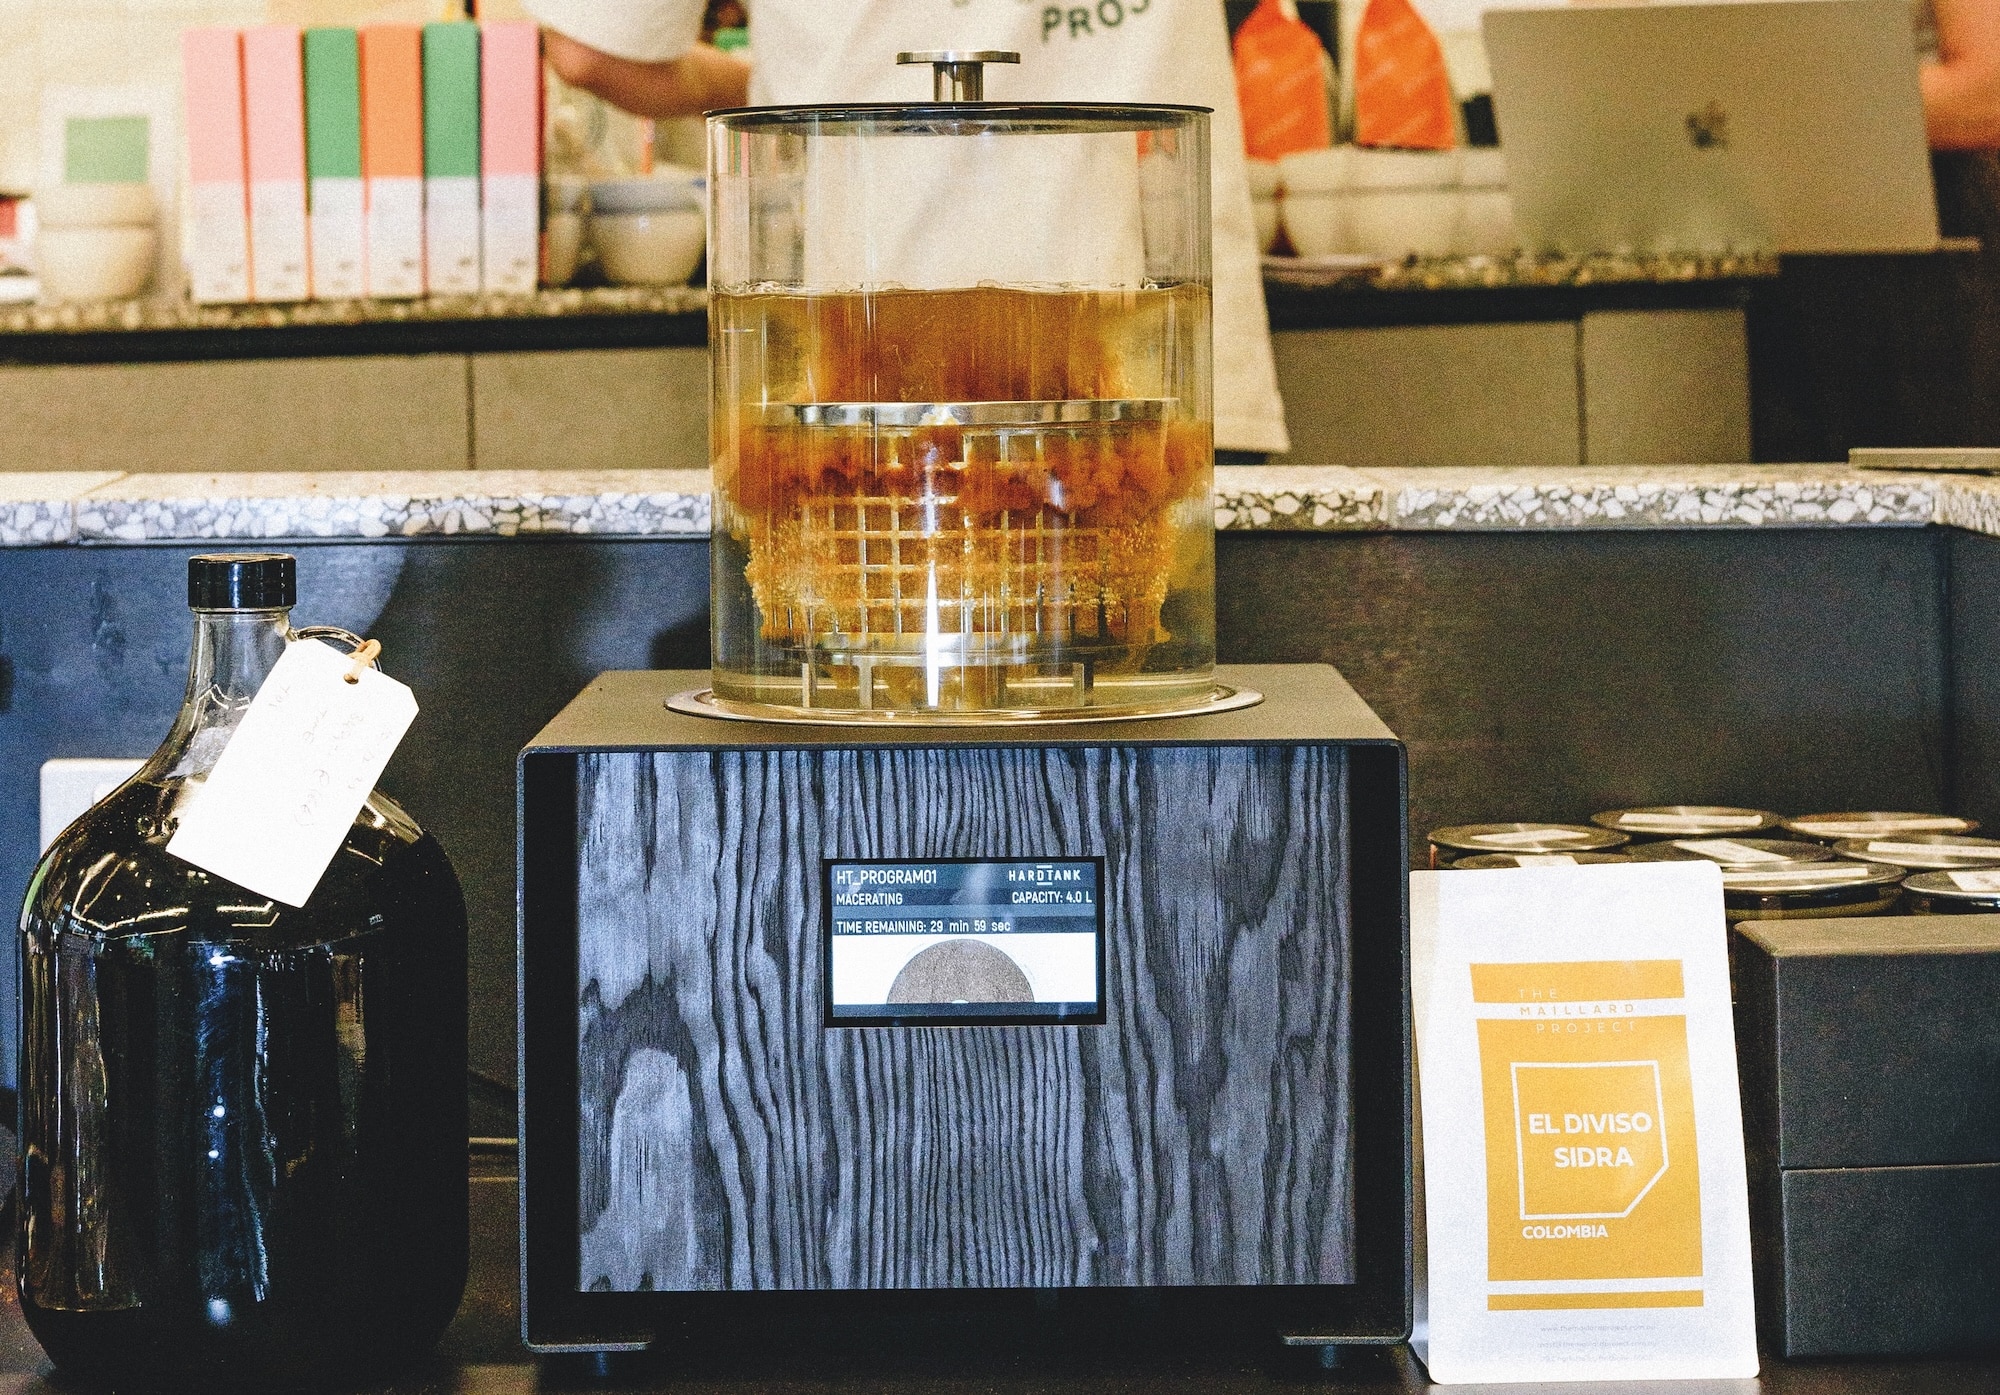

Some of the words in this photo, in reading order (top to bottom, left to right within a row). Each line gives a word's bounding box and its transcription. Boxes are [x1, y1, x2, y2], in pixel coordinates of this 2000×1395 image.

[836, 869, 937, 885] HT_PROGRAM01
[1008, 868, 1081, 882] HARDTANK
[836, 893, 903, 905] MACERATING
[1011, 891, 1064, 904] CAPACITY:
[1066, 890, 1082, 904] 4.0
[1085, 890, 1092, 904] L
[836, 921, 863, 934] TIME
[865, 920, 927, 933] REMAINING:
[930, 920, 943, 933] 29
[949, 920, 969, 932] min
[974, 919, 987, 932] 59
[991, 921, 1011, 932] sec
[1519, 988, 1558, 999] THE
[1520, 1003, 1634, 1016] MAILLARD
[1536, 1020, 1636, 1034] PROJECT
[1528, 1112, 1561, 1135] EL
[1563, 1111, 1653, 1134] DIVISO
[1553, 1145, 1635, 1168] SIDRA
[1521, 1224, 1609, 1239] COLOMBIA
